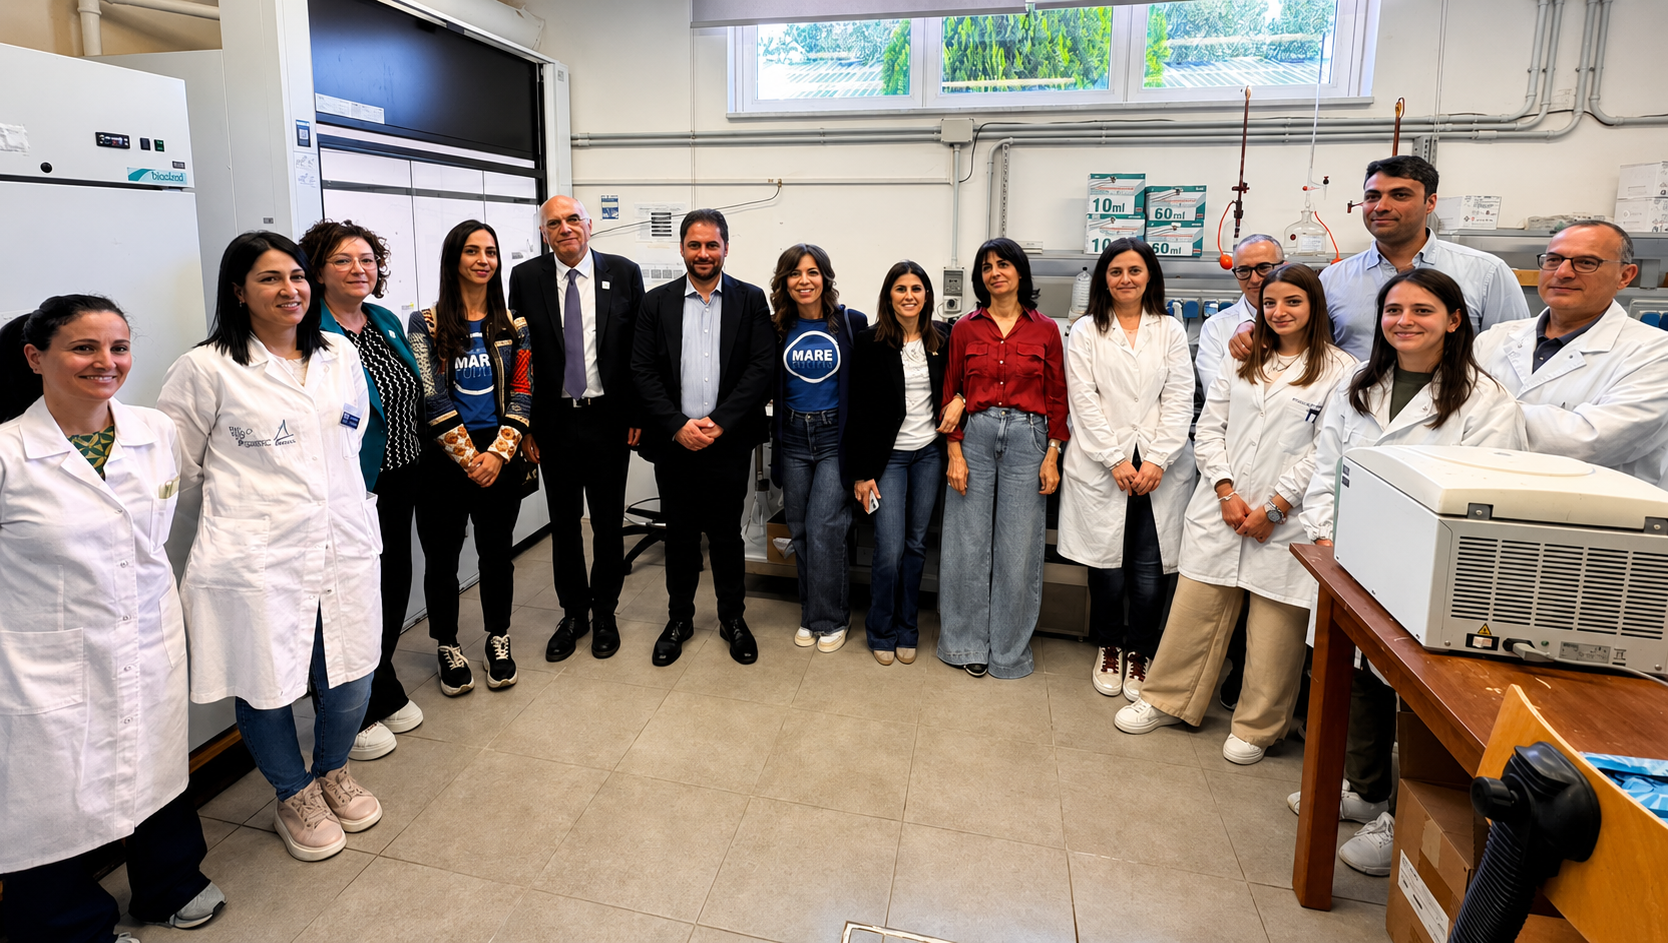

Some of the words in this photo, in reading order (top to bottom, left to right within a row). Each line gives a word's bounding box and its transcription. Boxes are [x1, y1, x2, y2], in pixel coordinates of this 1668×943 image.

[1093, 198, 1125, 212] 10ml
[1154, 207, 1185, 220] 60ml
[1152, 242, 1182, 255] 60ml
[454, 353, 491, 369] MAR
[792, 349, 833, 361] MARE
